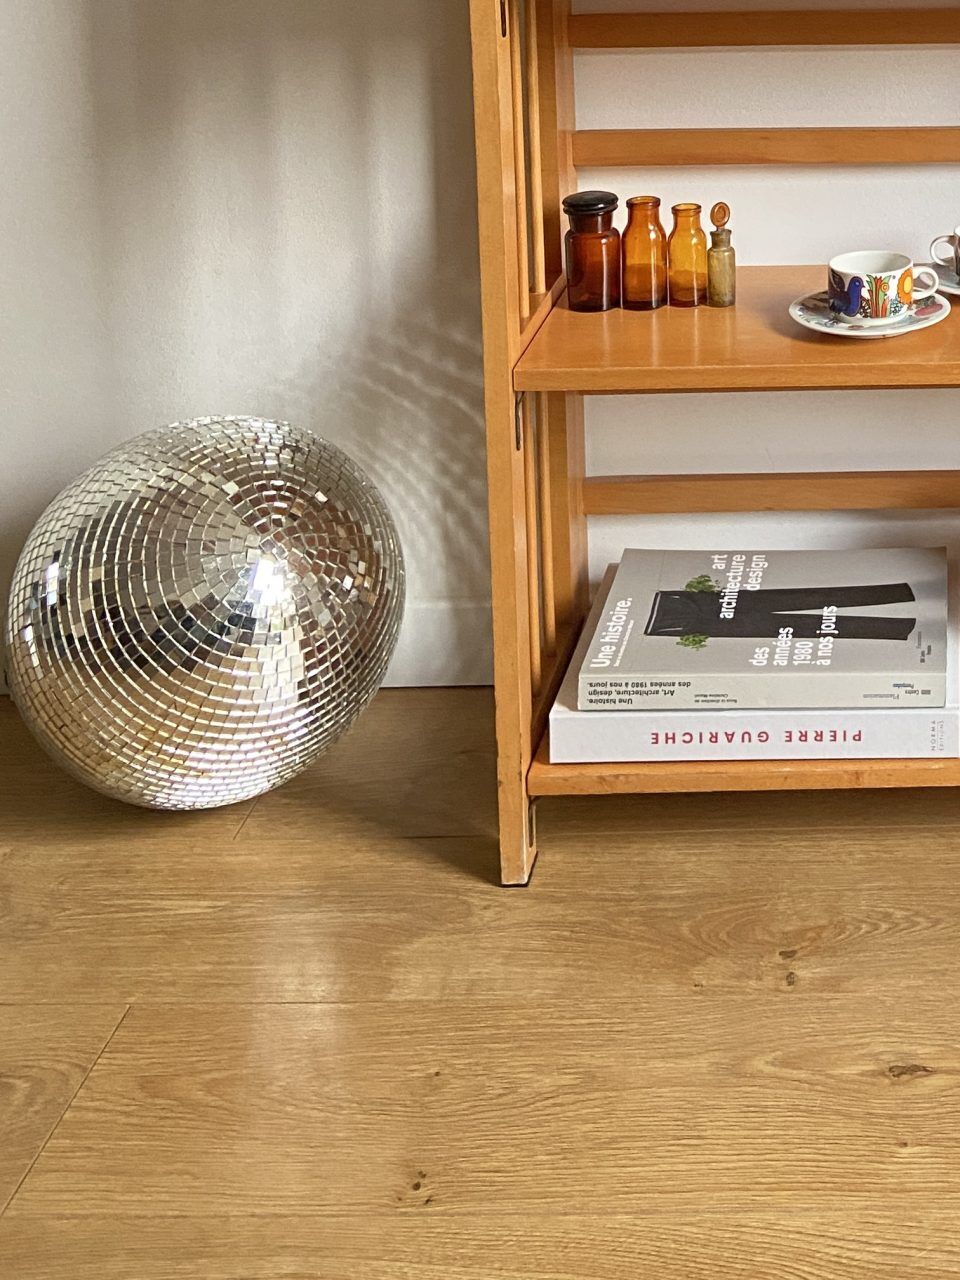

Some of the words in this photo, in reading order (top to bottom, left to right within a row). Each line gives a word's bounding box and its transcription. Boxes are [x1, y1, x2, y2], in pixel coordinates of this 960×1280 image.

[711, 554, 728, 570] art
[743, 555, 768, 591] design
[719, 554, 746, 619] architecture
[600, 598, 633, 642] histoire.
[816, 605, 839, 634] jours
[590, 645, 616, 668] Une
[749, 646, 770, 666] des
[772, 627, 794, 666] années
[793, 641, 814, 665] 1980
[818, 636, 834, 657] nos
[588, 688, 613, 697] design
[650, 730, 769, 745] GUARICHE
[785, 729, 862, 743] PIERRE
